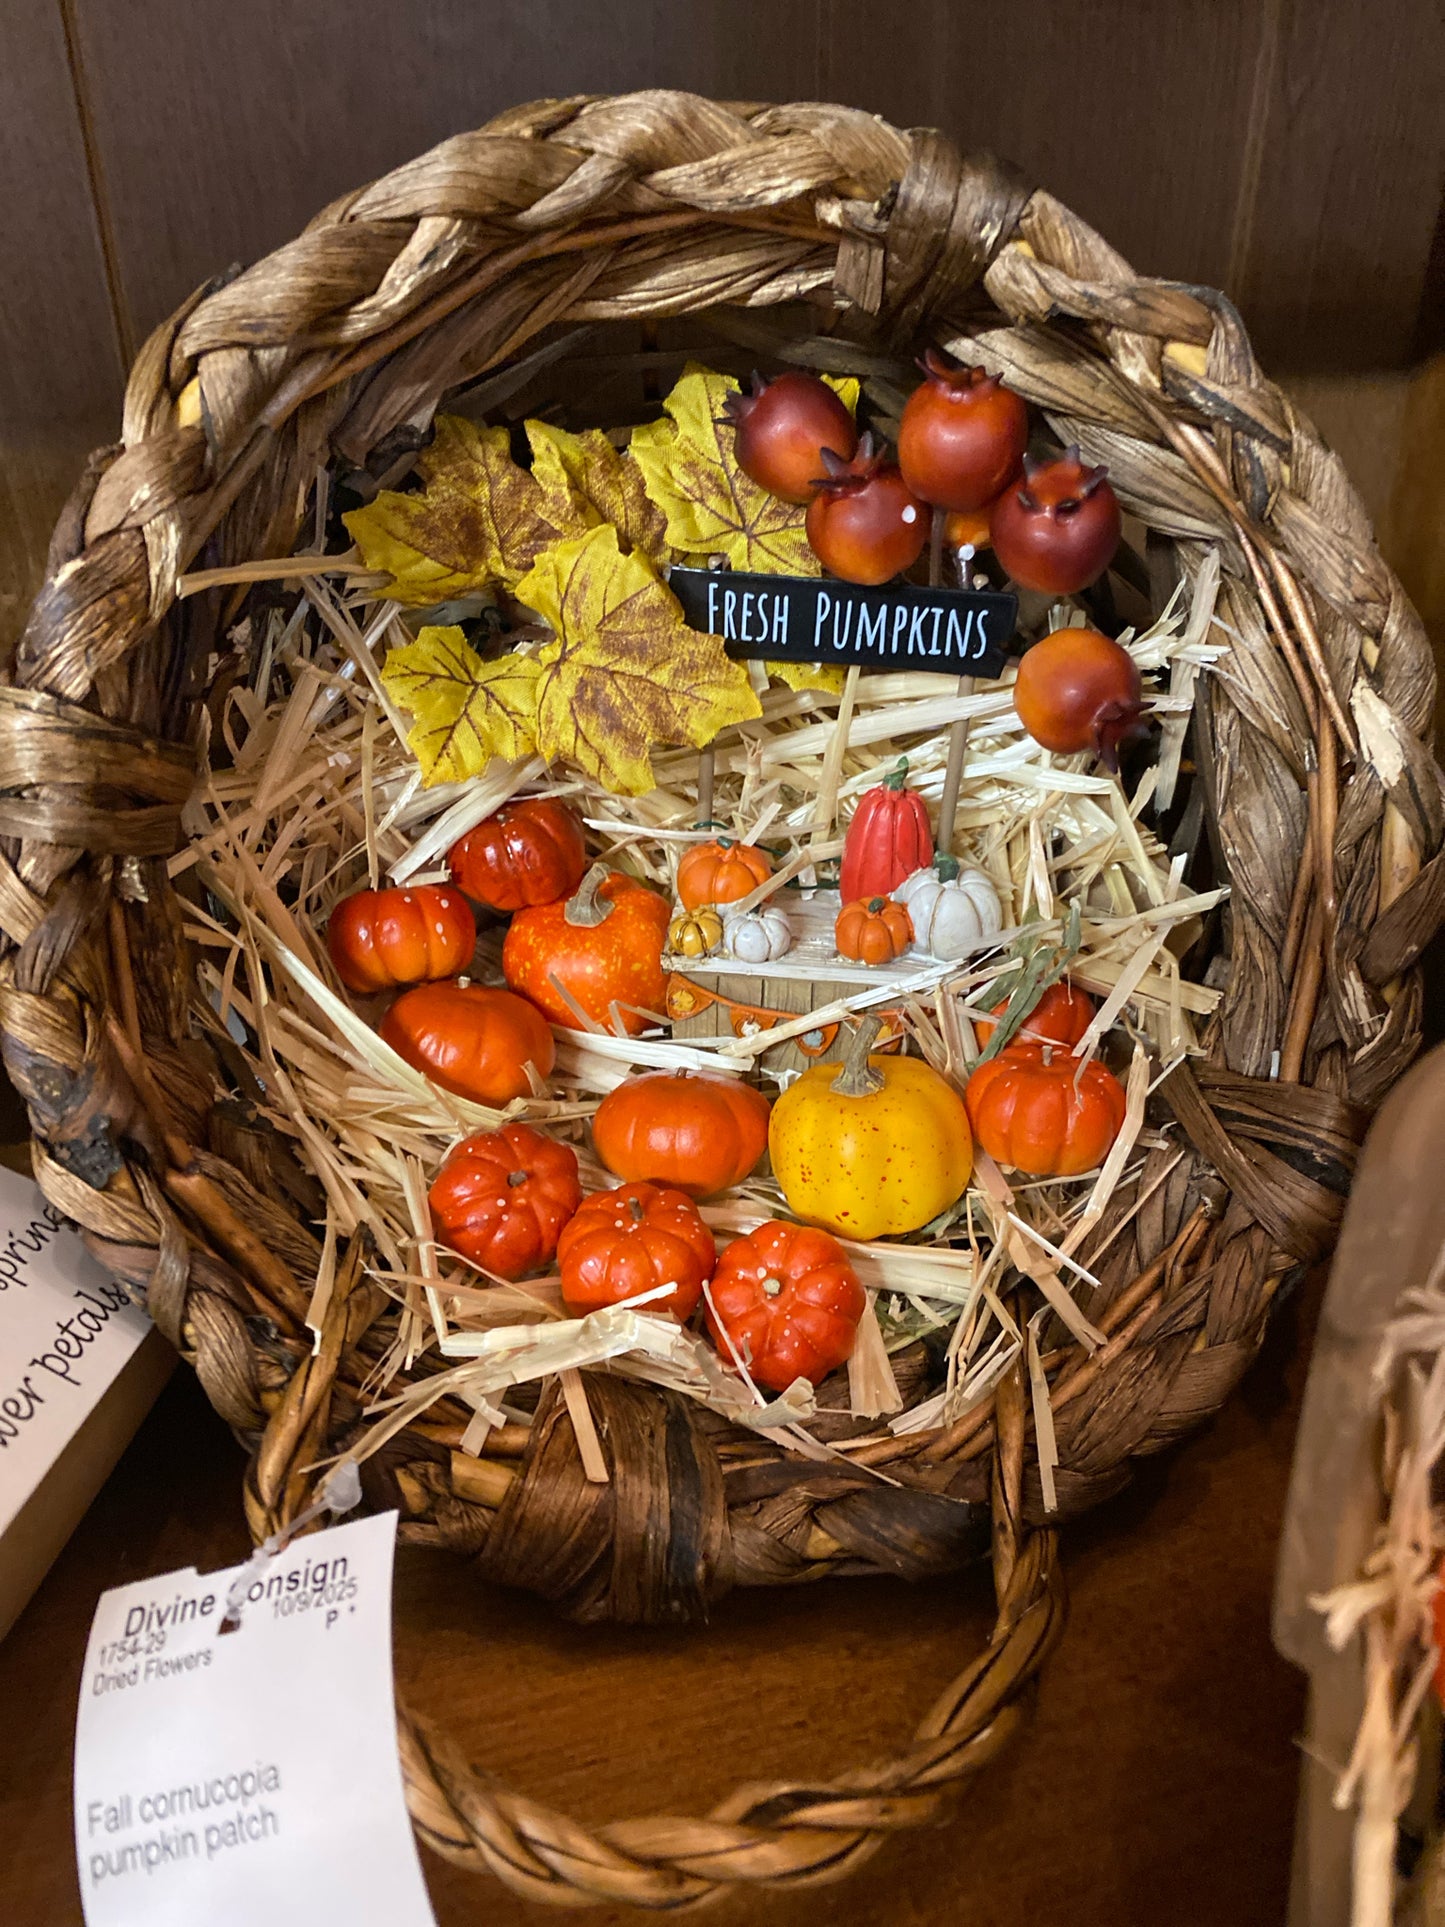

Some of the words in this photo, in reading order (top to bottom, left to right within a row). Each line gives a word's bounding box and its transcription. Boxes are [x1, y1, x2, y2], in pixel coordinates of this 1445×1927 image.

[708, 582, 790, 645] FRESH
[814, 591, 989, 659] PUMPKINS
[28, 1278, 131, 1386] petals
[124, 1593, 216, 1638] Divine
[228, 1556, 348, 1608] onsign
[272, 1577, 359, 1620] 10/9/2025
[91, 1662, 139, 1697] Dried
[142, 1647, 213, 1683] Flowers
[100, 1631, 167, 1666] 1754-29
[88, 1796, 132, 1836] Fall
[139, 1762, 280, 1823] cornucopia
[89, 1828, 199, 1886] pumpkin
[204, 1805, 280, 1861] patch
